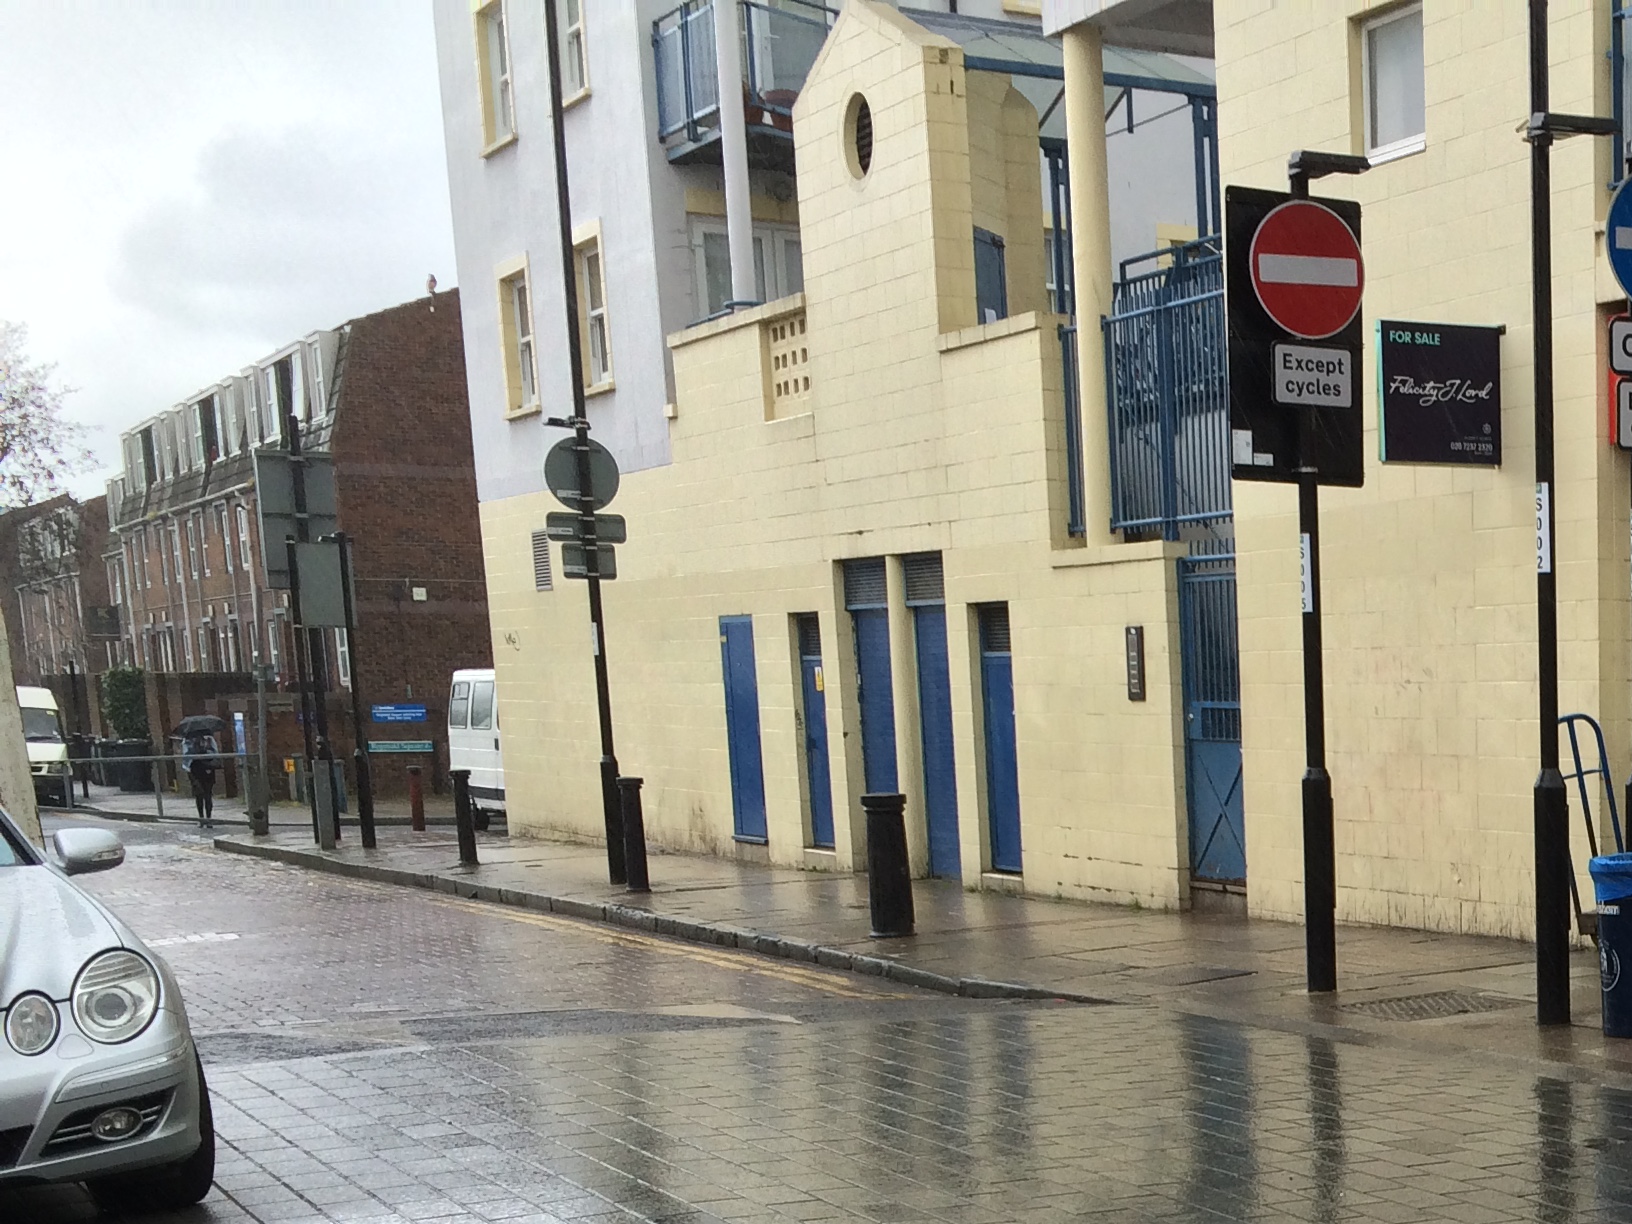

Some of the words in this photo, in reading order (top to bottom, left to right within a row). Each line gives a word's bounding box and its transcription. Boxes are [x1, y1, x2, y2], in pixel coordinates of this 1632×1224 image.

[1389, 330, 1411, 343] FOR
[1414, 332, 1441, 346] SALE
[1282, 352, 1345, 377] Except
[1285, 378, 1342, 397] cycles
[1389, 375, 1444, 406] Felicity
[1457, 379, 1493, 403] Lord
